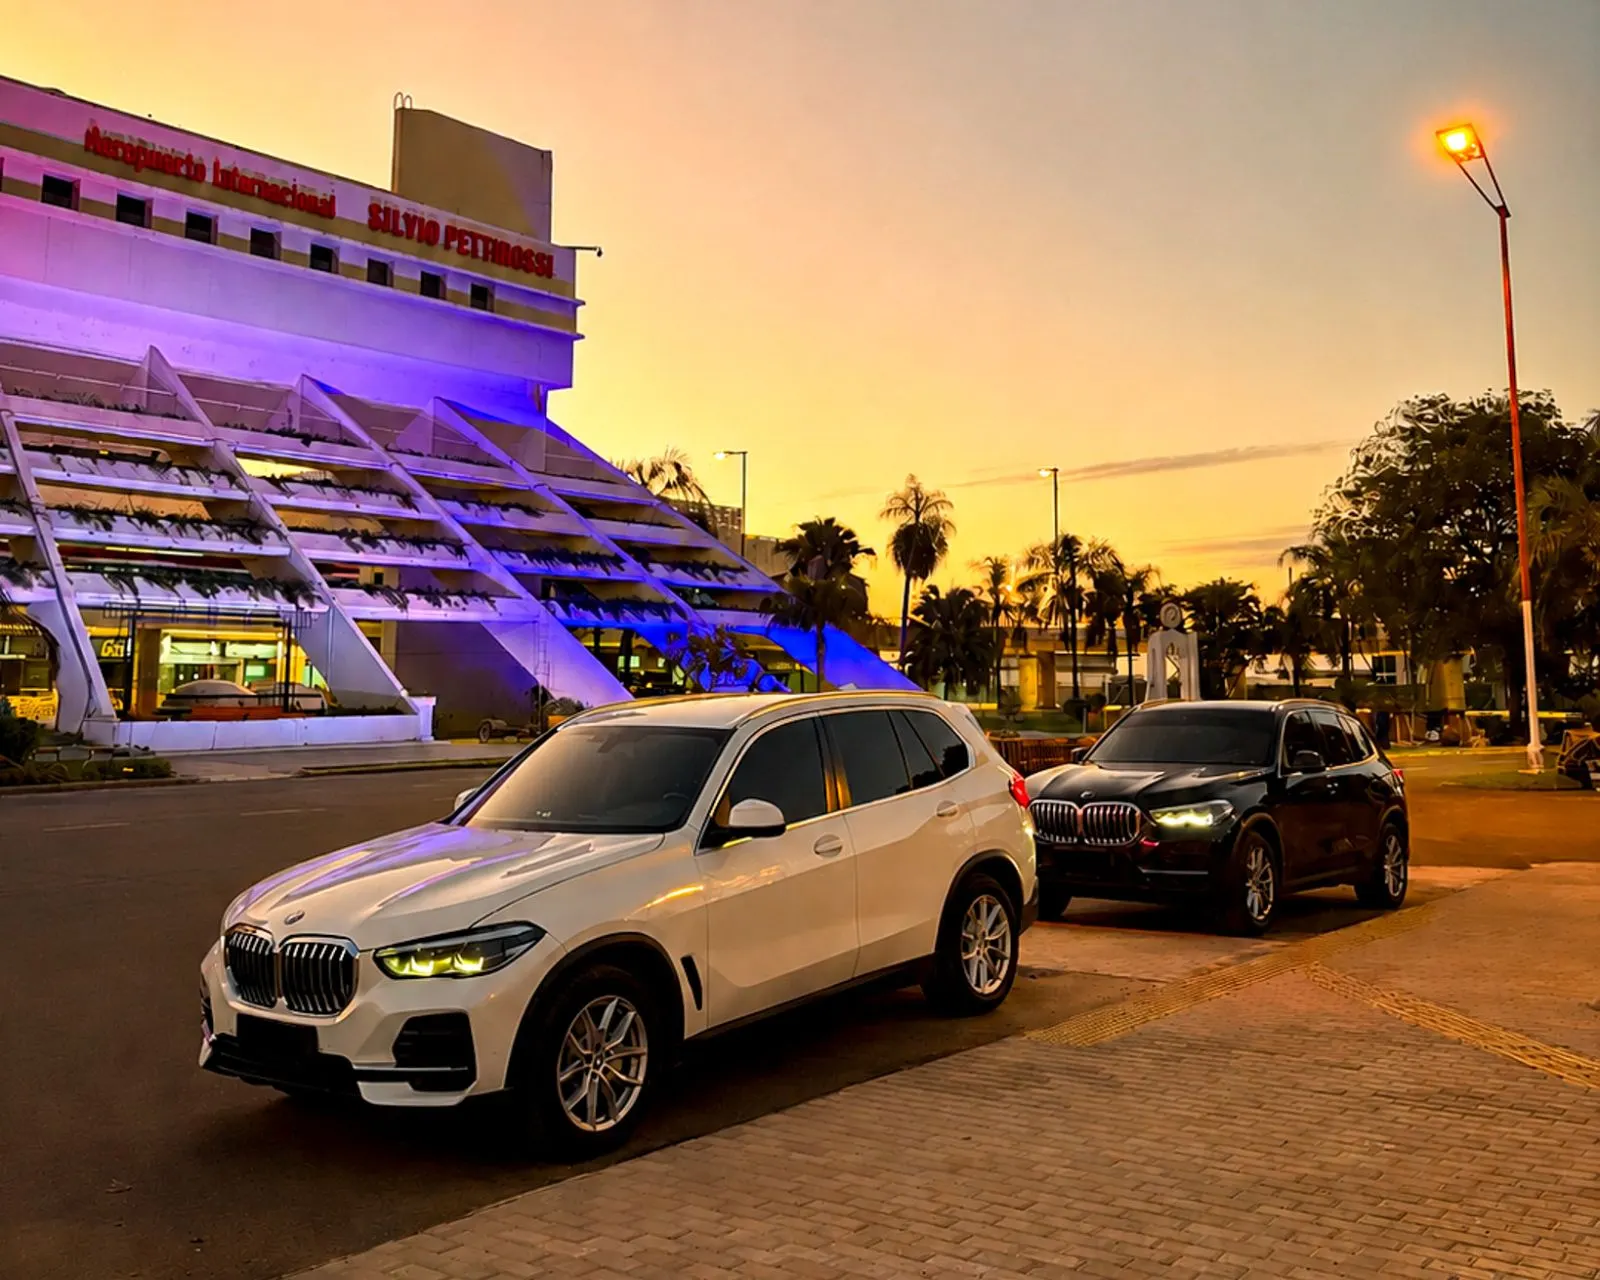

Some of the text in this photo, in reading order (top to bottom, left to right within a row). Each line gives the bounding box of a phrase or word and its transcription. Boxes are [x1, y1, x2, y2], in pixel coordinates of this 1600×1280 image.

[84, 126, 336, 219] Aeropuerto Internacional
[367, 203, 554, 279] SILVIO PETTIROSSI
